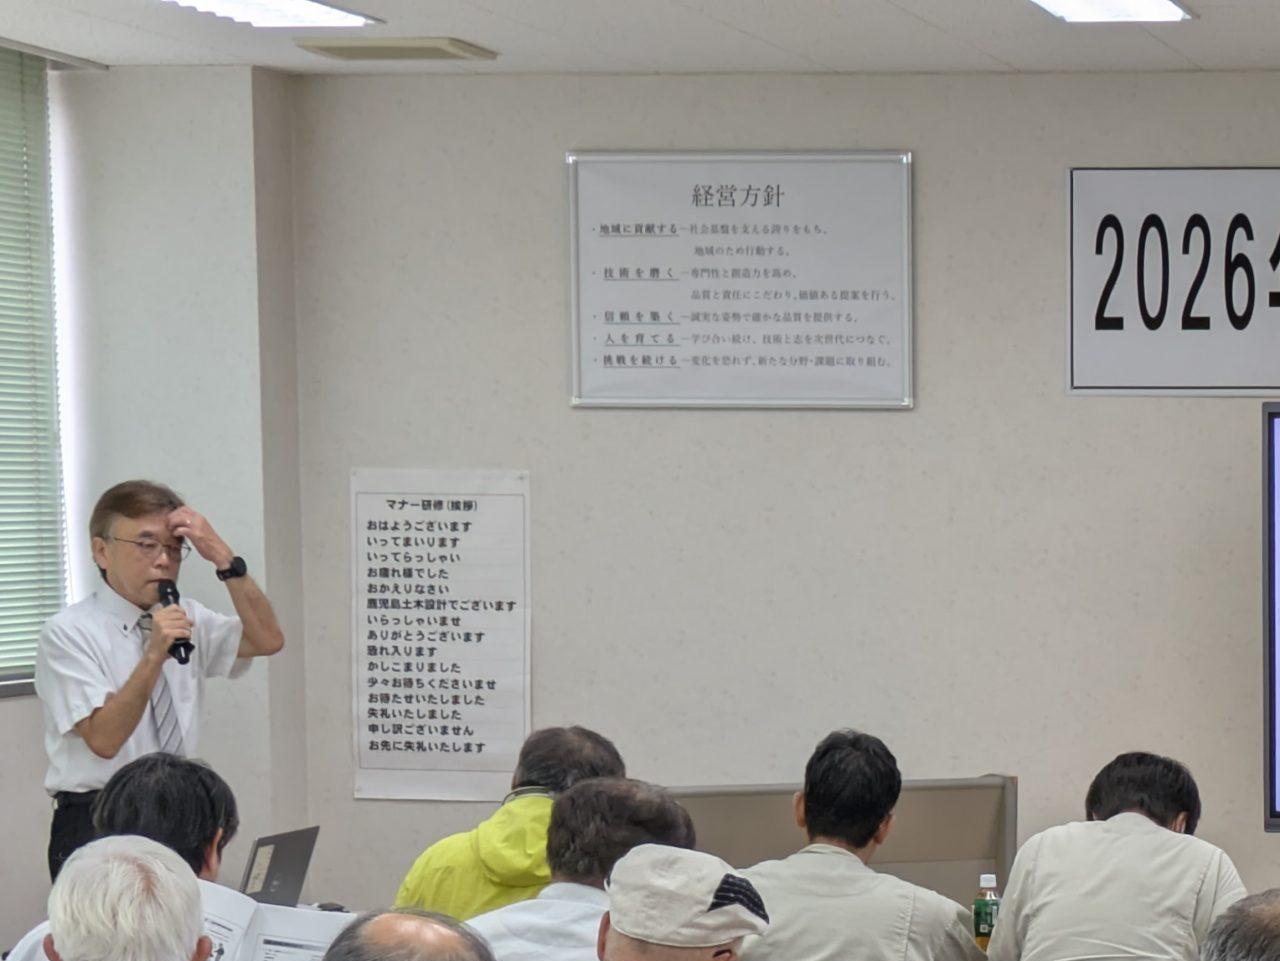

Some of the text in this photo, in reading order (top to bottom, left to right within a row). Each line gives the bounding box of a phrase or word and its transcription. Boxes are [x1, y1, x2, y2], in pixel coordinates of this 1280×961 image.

[693, 184, 784, 207] 経営方針
[367, 520, 471, 532] おはようございます
[367, 537, 459, 548] いってまいります
[367, 552, 460, 563] いってらっしゃい
[368, 567, 448, 579] お疲れ様でした
[368, 583, 449, 595] おかえりなさい
[367, 598, 516, 611] 鹿児島土木設計でございます
[368, 615, 461, 626] いらっしゃいませ
[368, 630, 484, 642] ありがとうございます
[367, 645, 437, 657] 恐れ入ります
[368, 661, 460, 673] かしこまりました
[368, 677, 496, 690] 少々お待ちくださいませ
[368, 693, 484, 705] お待たせいたしました
[368, 708, 461, 720] 失礼いたしました
[368, 724, 473, 736] 申し訳ございません
[369, 740, 485, 753] お先に失礼いたします
